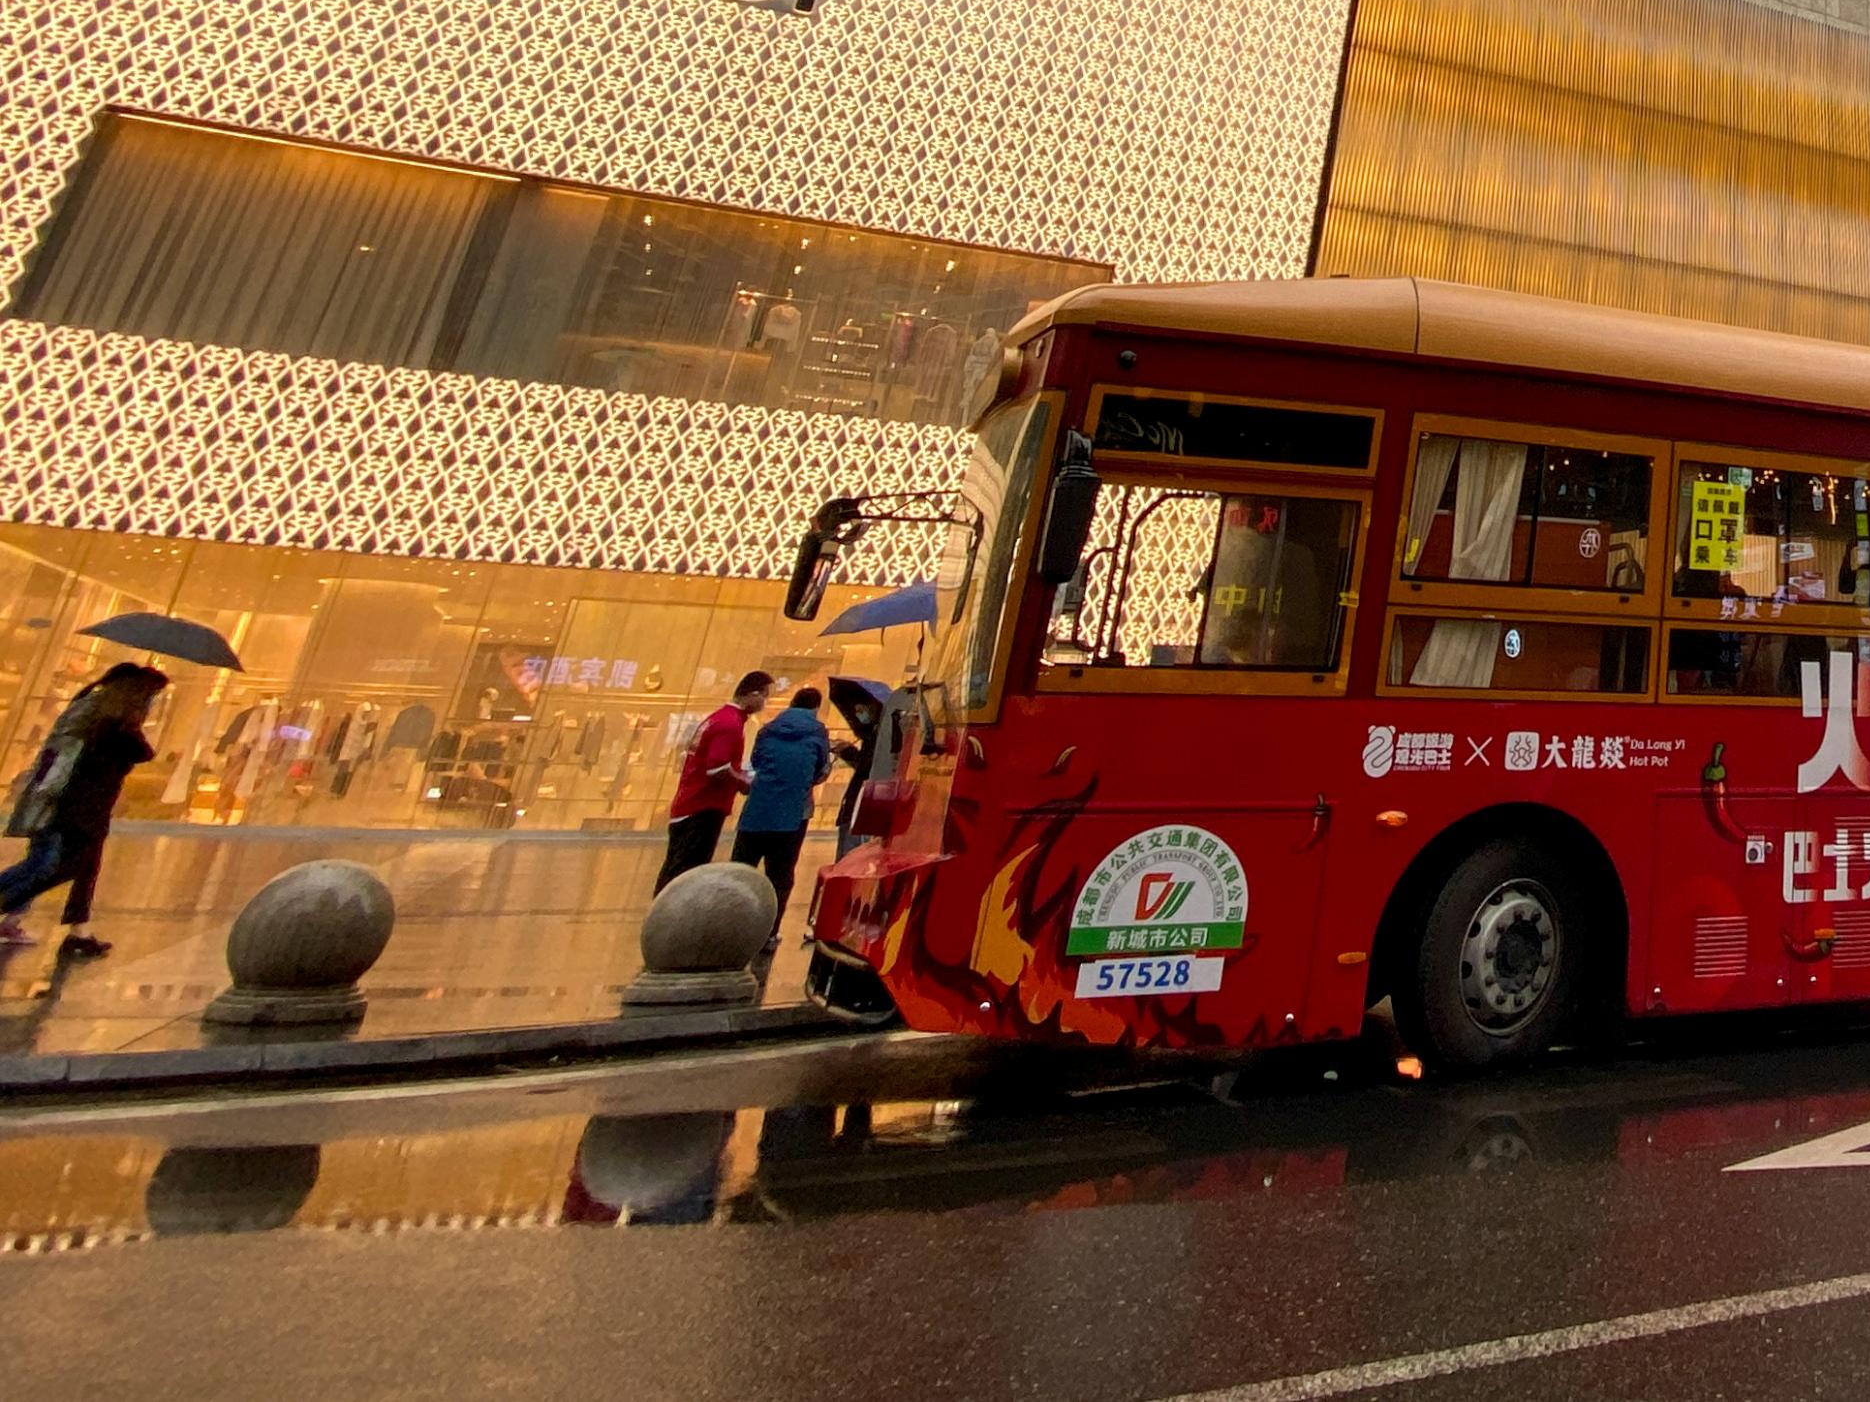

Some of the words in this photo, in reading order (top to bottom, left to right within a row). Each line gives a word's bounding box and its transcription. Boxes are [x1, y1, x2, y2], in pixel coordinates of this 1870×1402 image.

[1650, 755, 1669, 767] Pot
[1076, 829, 1244, 926] 成都市公共交通集团有限公司
[1106, 927, 1209, 951] 新城市公司
[1096, 959, 1192, 991] 57528
